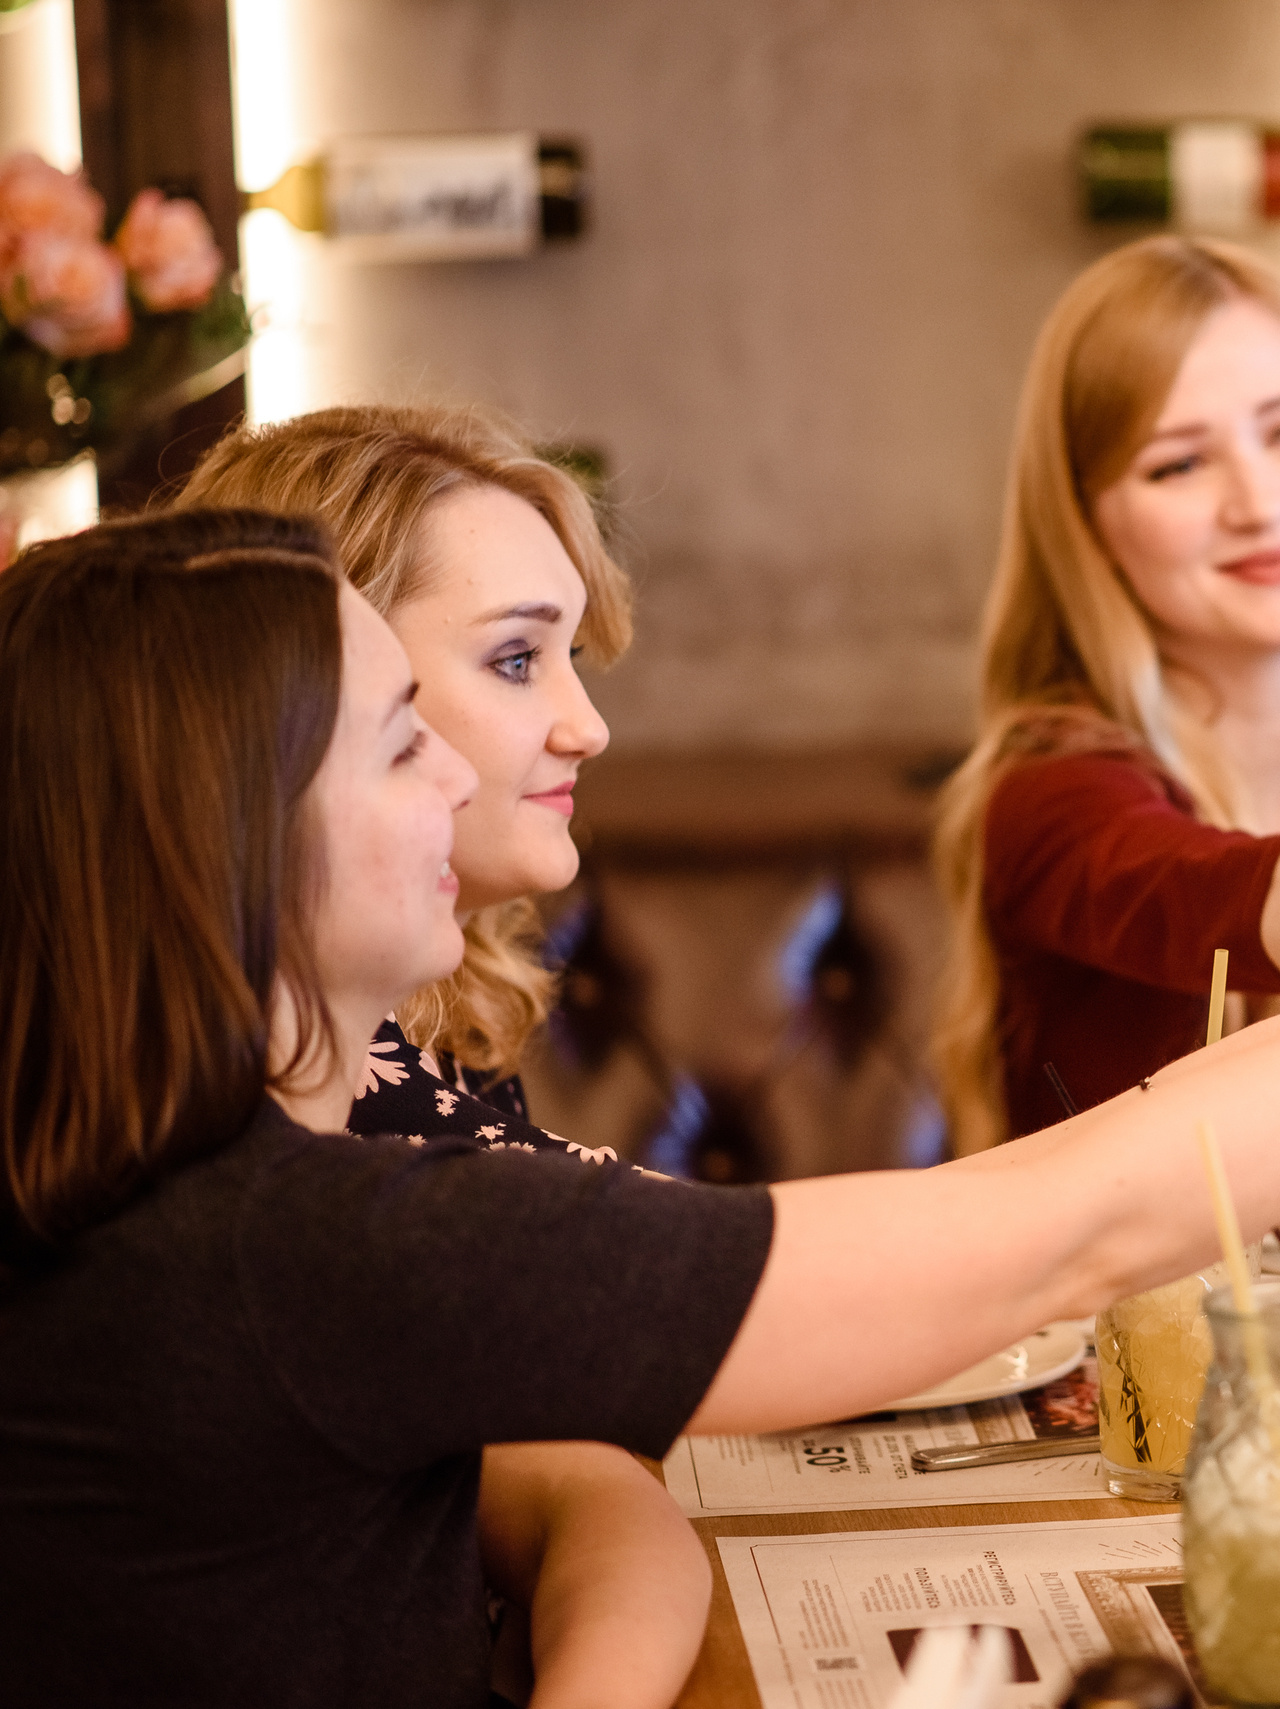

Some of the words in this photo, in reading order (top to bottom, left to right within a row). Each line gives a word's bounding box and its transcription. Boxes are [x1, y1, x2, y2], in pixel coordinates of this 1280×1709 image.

[803, 1446, 852, 1473] 50%
[913, 1567, 941, 1609] ПОЛЬЗУЙТЕСЬ
[983, 1550, 1017, 1607] РЕГИСТРИРУЙТЕСЬ
[1040, 1572, 1082, 1622] ВСТУПАЙТЕ
